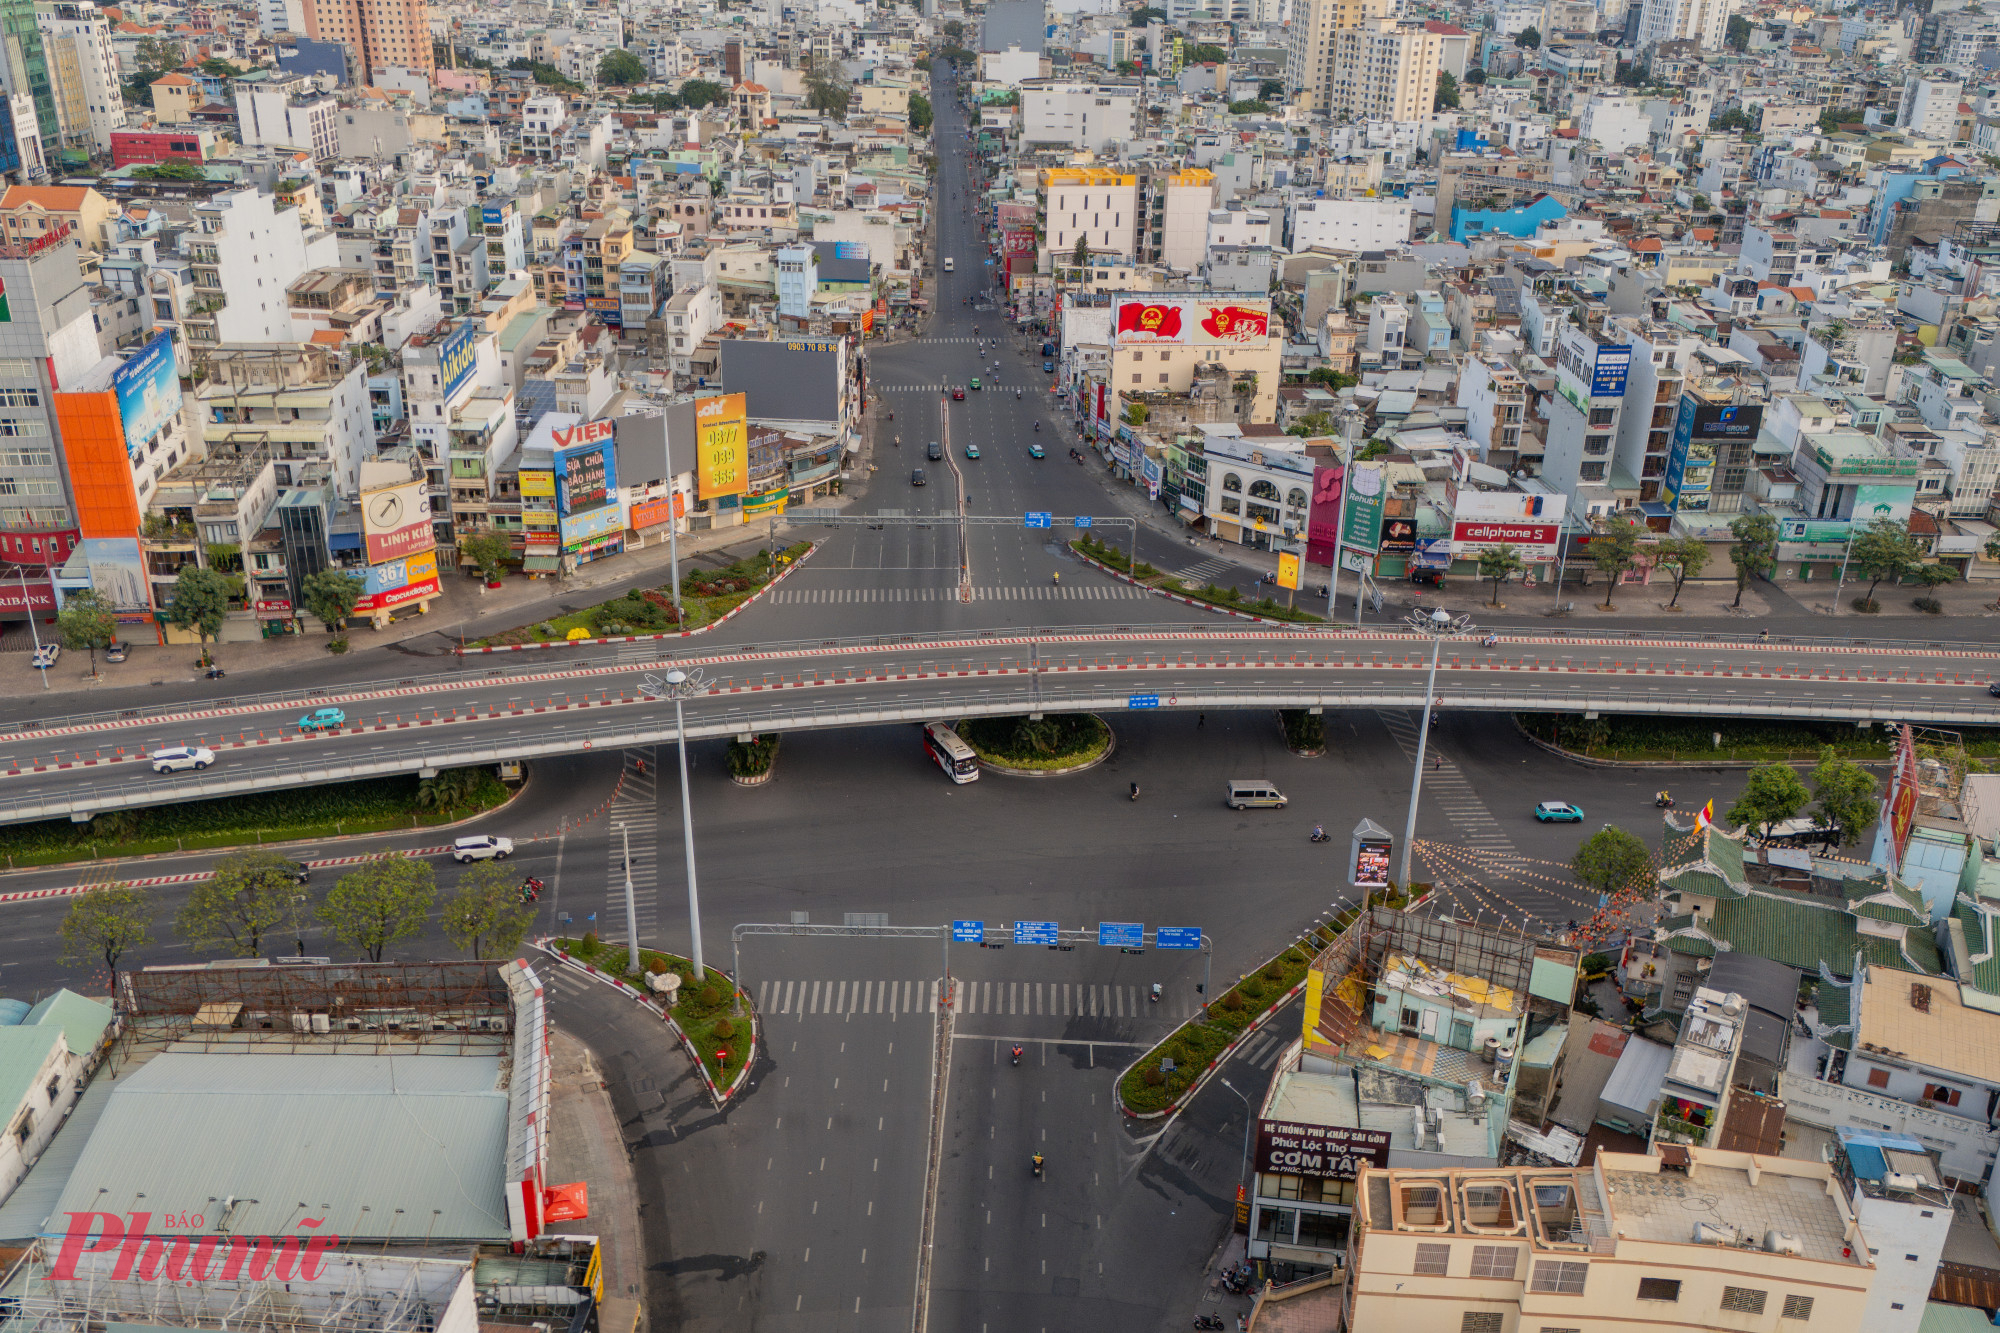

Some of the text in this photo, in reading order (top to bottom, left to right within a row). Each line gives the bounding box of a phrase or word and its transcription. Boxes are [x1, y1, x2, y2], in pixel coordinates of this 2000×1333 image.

[28, 222, 71, 256] AGRIBANK
[788, 342, 837, 352] 0903 70 85 96
[443, 338, 474, 390] Aikido
[552, 419, 612, 447] VIỆN
[708, 428, 737, 446] 0877
[567, 452, 604, 472] SỬA CHỮA
[586, 468, 605, 482] HÀNH
[1668, 476, 1678, 489] ONE
[590, 488, 606, 500] 1080
[606, 488, 617, 499] 26
[1349, 492, 1379, 506] RehubX
[584, 512, 600, 520] MÁY
[603, 506, 619, 516] TÍNH
[380, 531, 410, 547] LINH
[568, 543, 582, 552] MUA
[378, 564, 405, 584] 367
[385, 583, 433, 603] Capcuudidong
[1264, 1124, 1275, 1133] HỆ
[1278, 1124, 1305, 1136] THỐNG
[1352, 1132, 1366, 1142] SÀI
[1368, 1134, 1386, 1144] GÒN
[1272, 1136, 1348, 1155] Phúc Lộc Thọ
[1270, 1151, 1322, 1168] CƠM
[1280, 1166, 1302, 1174] PHÚC,
[1303, 1168, 1321, 1176] uống
